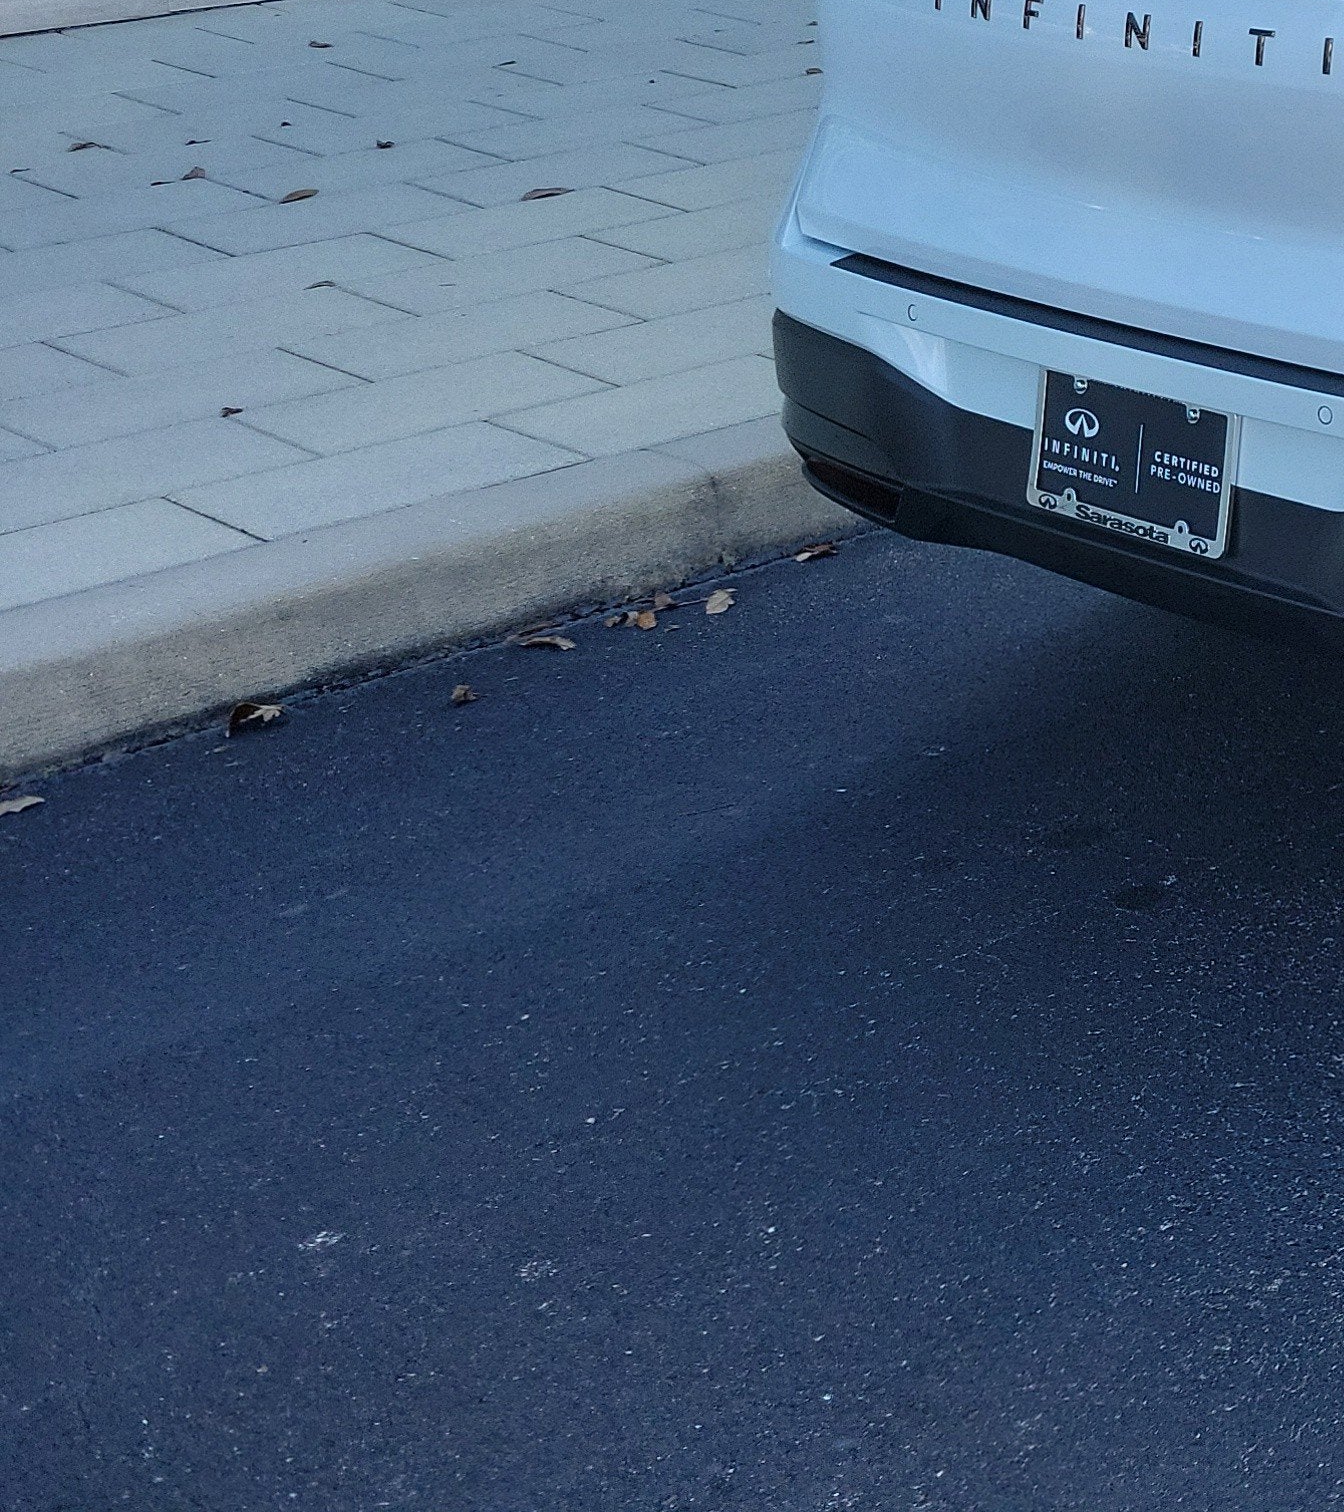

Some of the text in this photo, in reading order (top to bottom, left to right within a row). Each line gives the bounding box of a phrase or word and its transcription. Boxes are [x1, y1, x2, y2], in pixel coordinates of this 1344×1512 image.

[1042, 460, 1078, 478] EMPOWER
[1078, 469, 1093, 482] THE
[1154, 450, 1219, 478] CERTIFIED
[1150, 464, 1221, 494] PRE-OWNED
[1075, 503, 1171, 545] Sarasota
